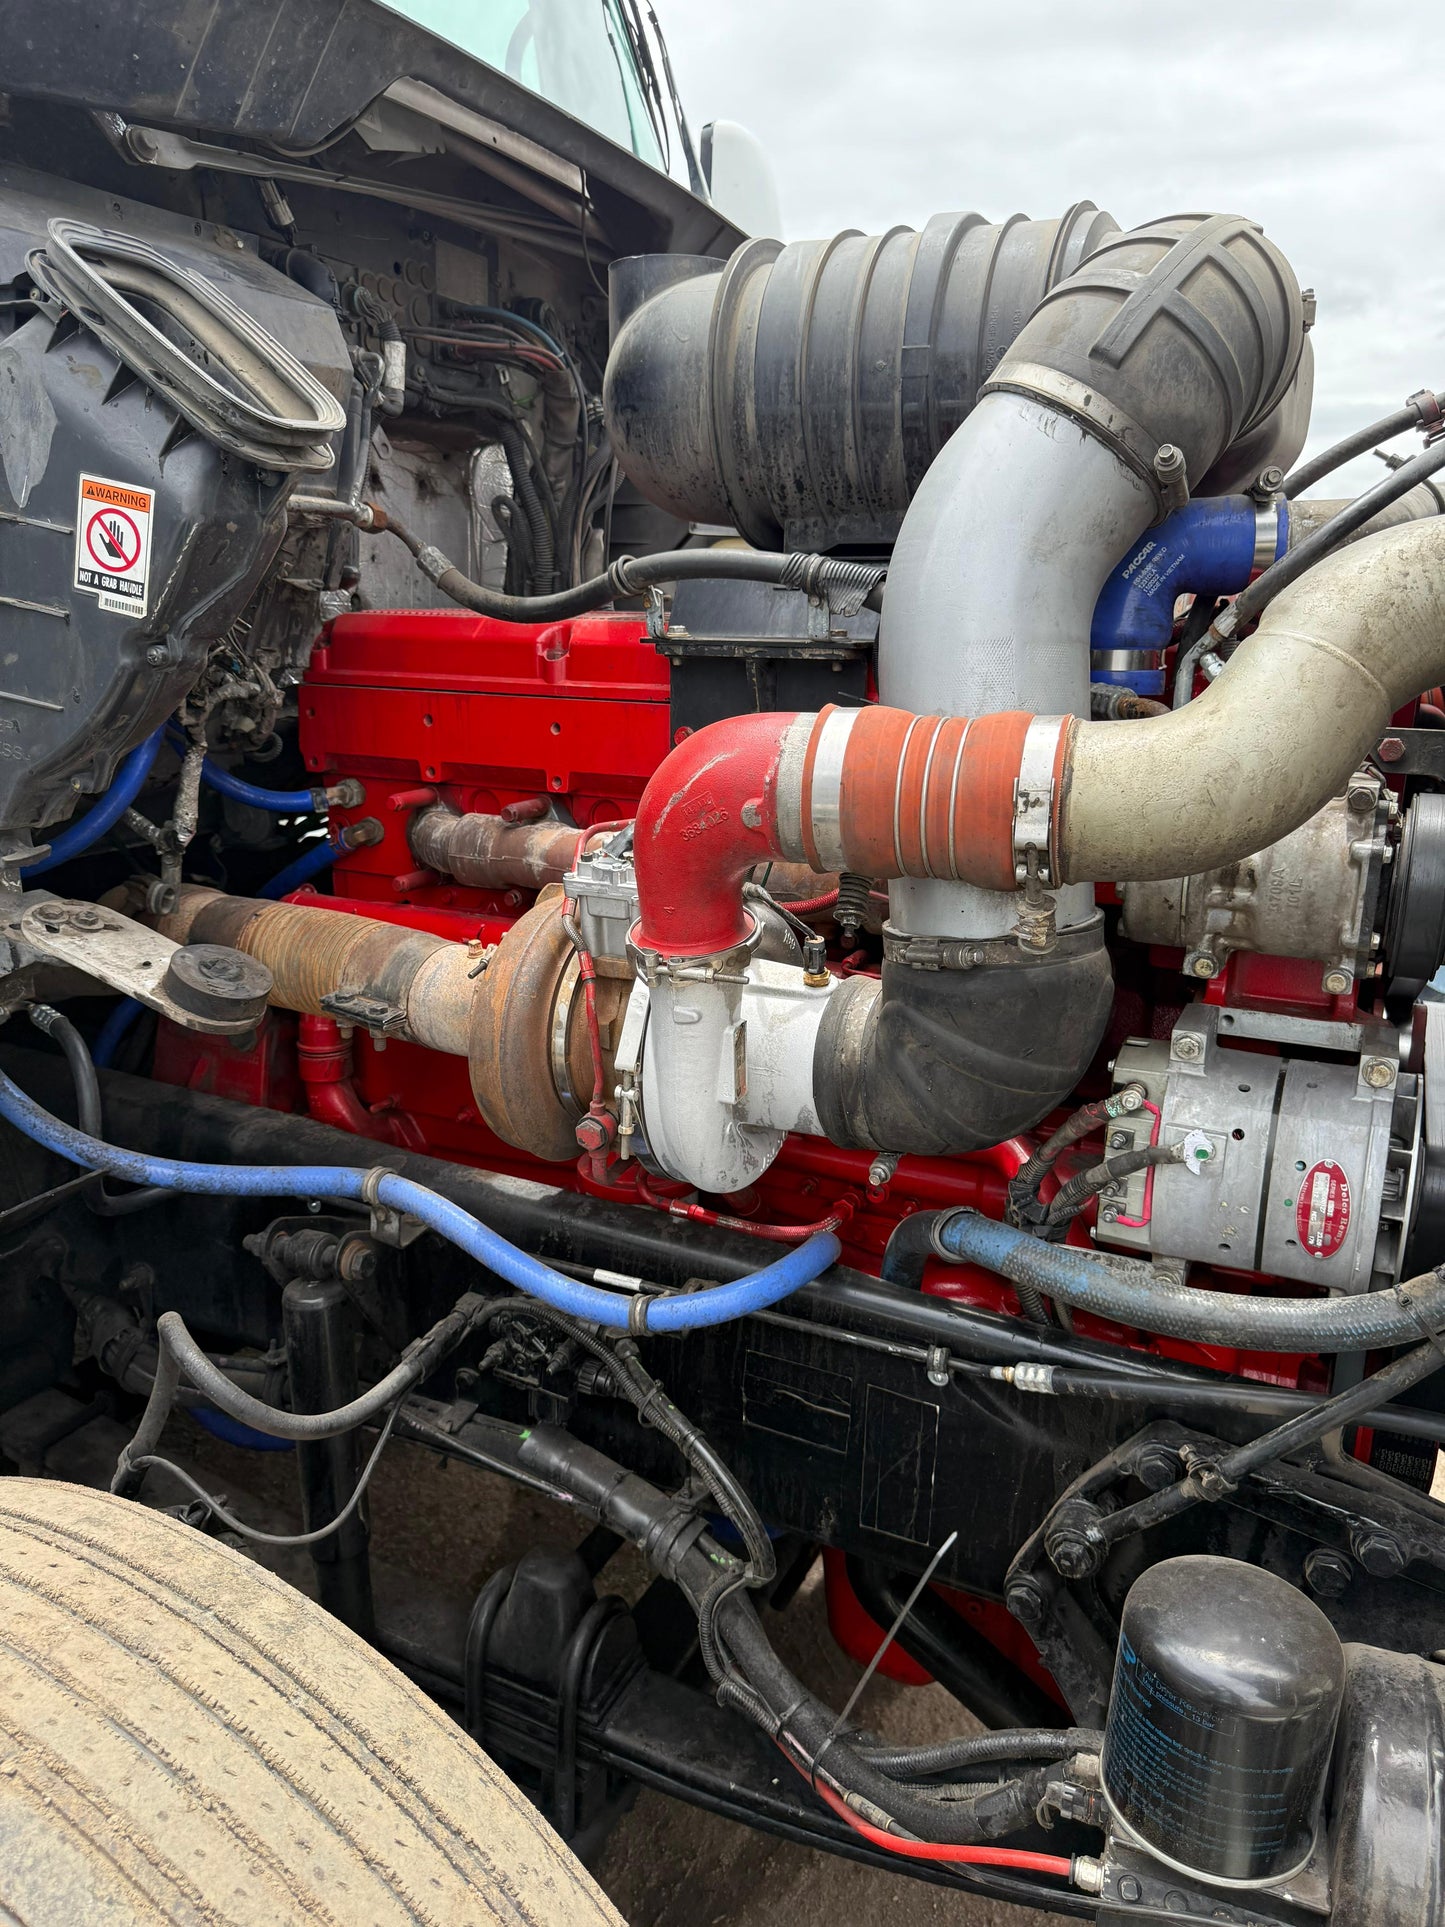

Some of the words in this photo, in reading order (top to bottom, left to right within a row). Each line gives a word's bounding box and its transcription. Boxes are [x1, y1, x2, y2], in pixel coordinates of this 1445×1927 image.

[95, 486, 147, 509] WARNING
[1121, 541, 1157, 579] PACCAR
[79, 570, 92, 584] NOT
[93, 575, 99, 586] A
[101, 577, 118, 590] GRAB
[119, 581, 143, 596] HANDLE
[1147, 581, 1162, 597] MADE
[1159, 575, 1167, 583] IN
[1164, 553, 1185, 576] VIETNAM
[1340, 1183, 1349, 1214] Delco
[1333, 1217, 1348, 1244] Remy
[1192, 1714, 1201, 1723] 13
[1202, 1718, 1216, 1729] bar
